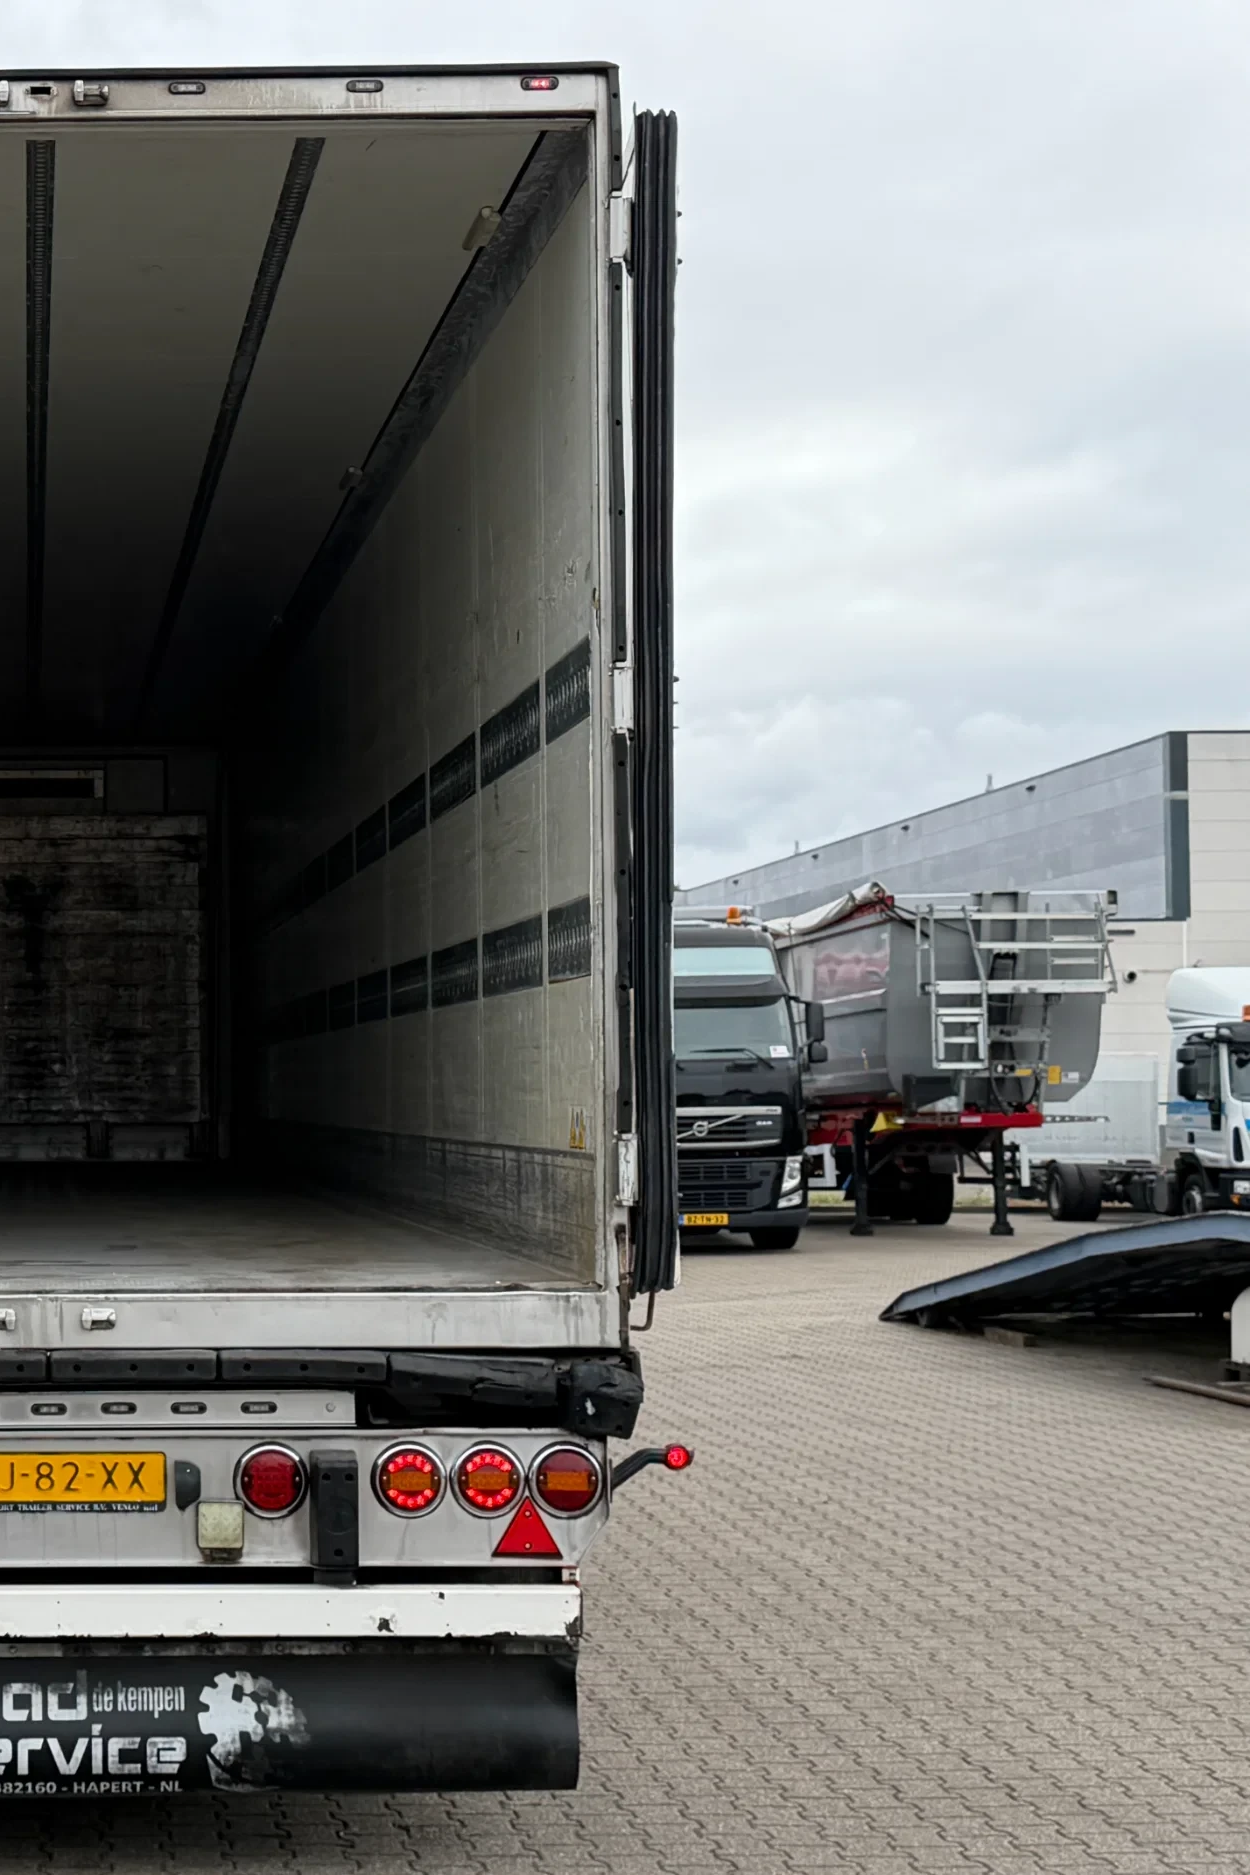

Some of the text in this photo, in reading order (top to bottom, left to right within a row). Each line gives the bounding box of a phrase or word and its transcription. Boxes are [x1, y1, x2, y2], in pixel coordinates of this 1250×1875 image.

[93, 1682, 113, 1712] de
[117, 1681, 185, 1717] kempen
[73, 1782, 144, 1793] HAPERT
[160, 1780, 183, 1792] NL
